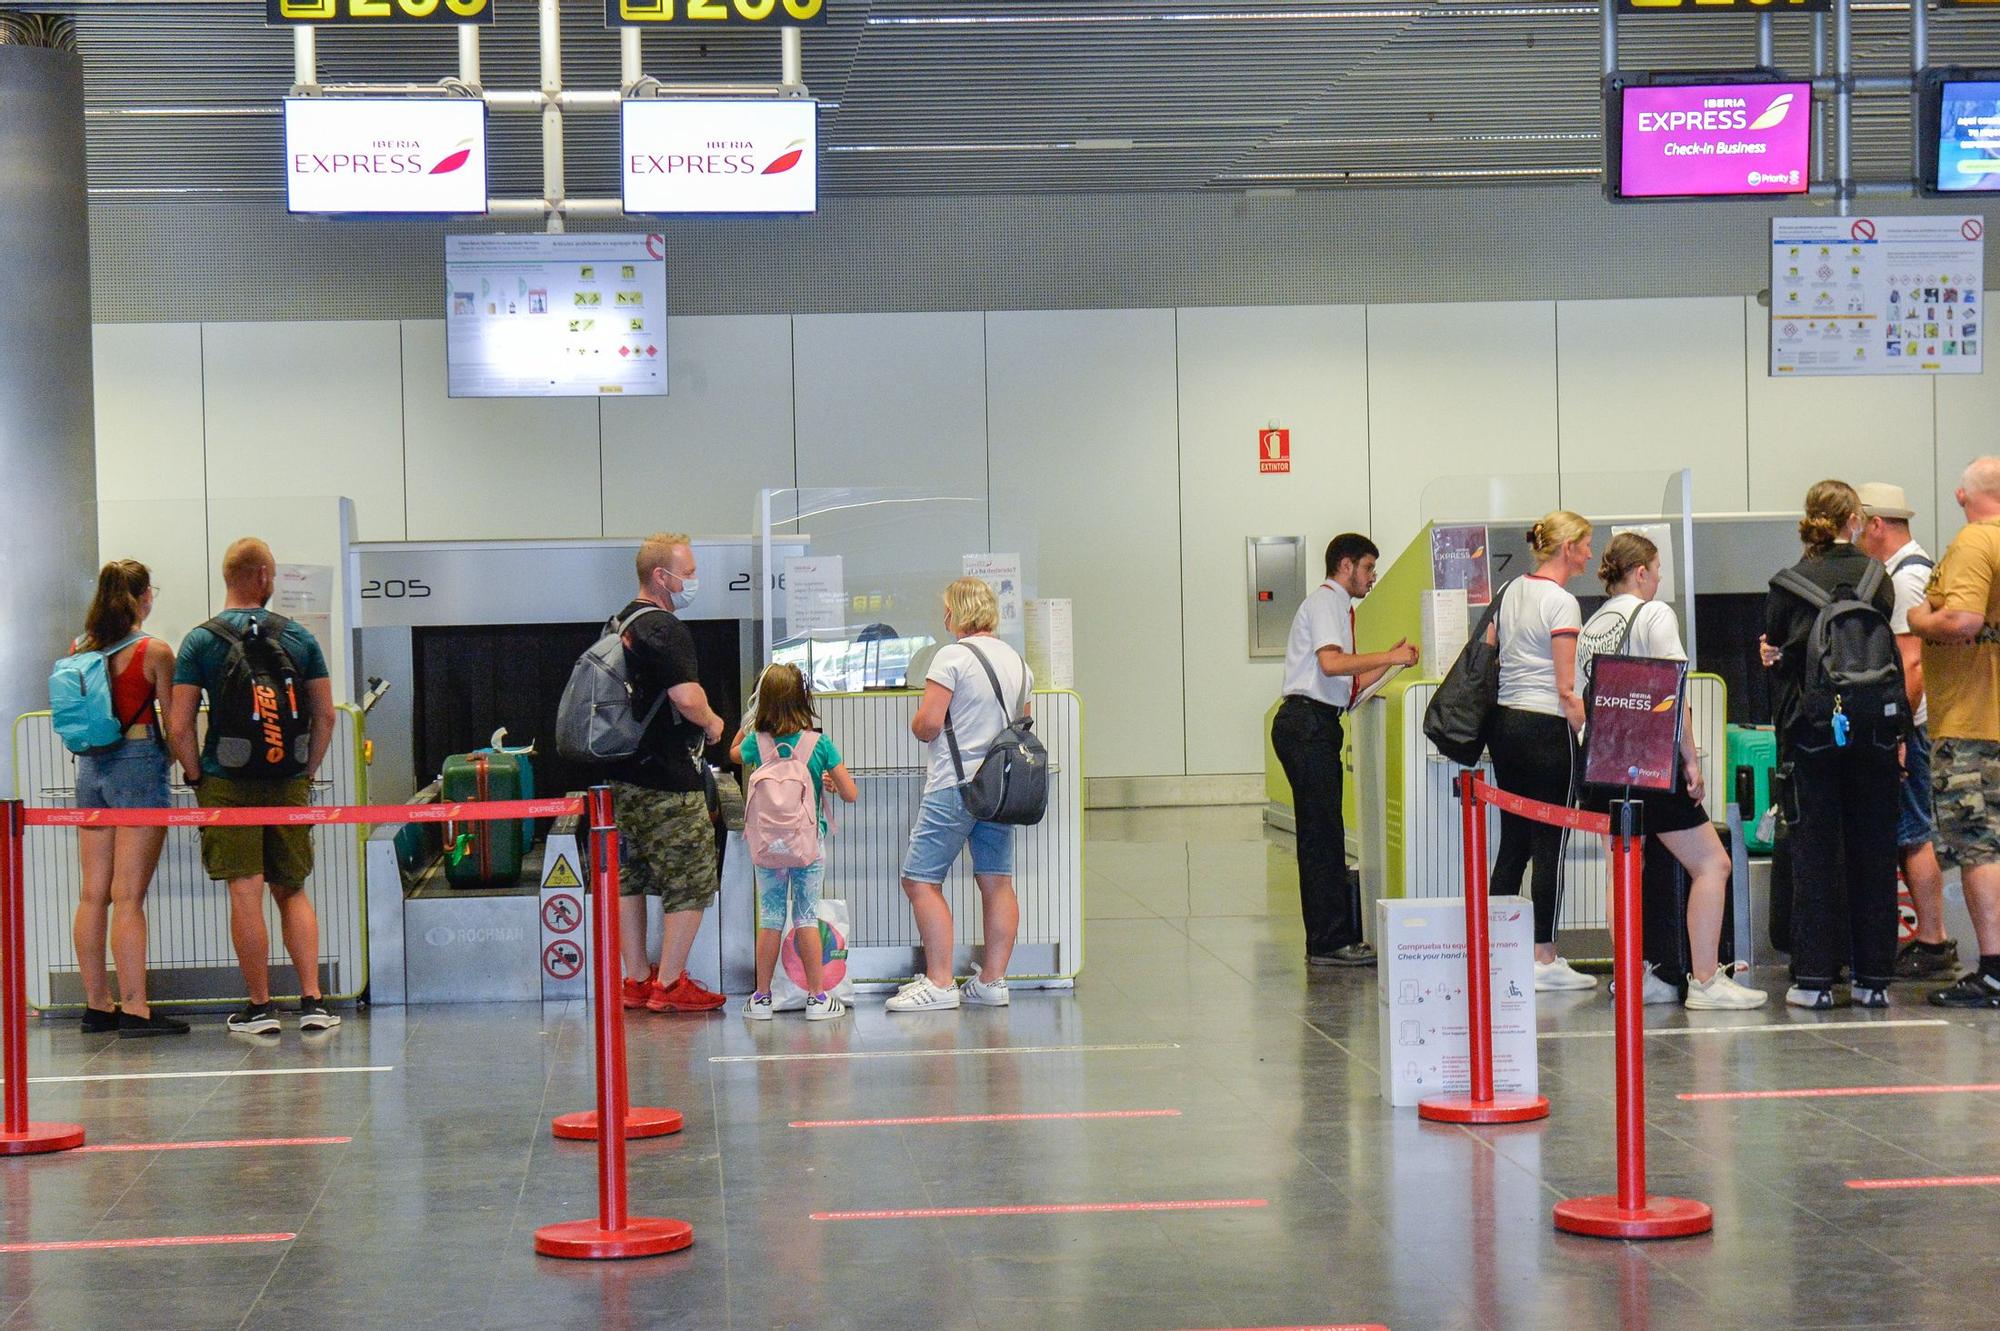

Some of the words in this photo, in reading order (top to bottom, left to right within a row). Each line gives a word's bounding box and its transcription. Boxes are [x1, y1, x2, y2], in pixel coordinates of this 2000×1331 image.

[1703, 98, 1746, 109] IBERIA
[1638, 110, 1747, 132] EXPRESS
[372, 140, 420, 148] IBERIA
[706, 141, 753, 149] IBERIA
[1663, 142, 1714, 156] Check-in
[1716, 141, 1767, 155] Business
[295, 154, 422, 174] EXPRESS
[631, 155, 755, 174] EXPRESS
[1261, 462, 1289, 471] EXTINTOR
[361, 579, 432, 598] 205
[1595, 695, 1652, 711] EXPRESS
[1629, 692, 1652, 700] IBERIA
[256, 685, 286, 752] HI-TEC
[1639, 768, 1660, 778] Priority
[457, 927, 524, 942] ROCHMAN
[1398, 952, 1422, 960] Check
[1423, 953, 1440, 961] your
[1441, 951, 1461, 959] hand
